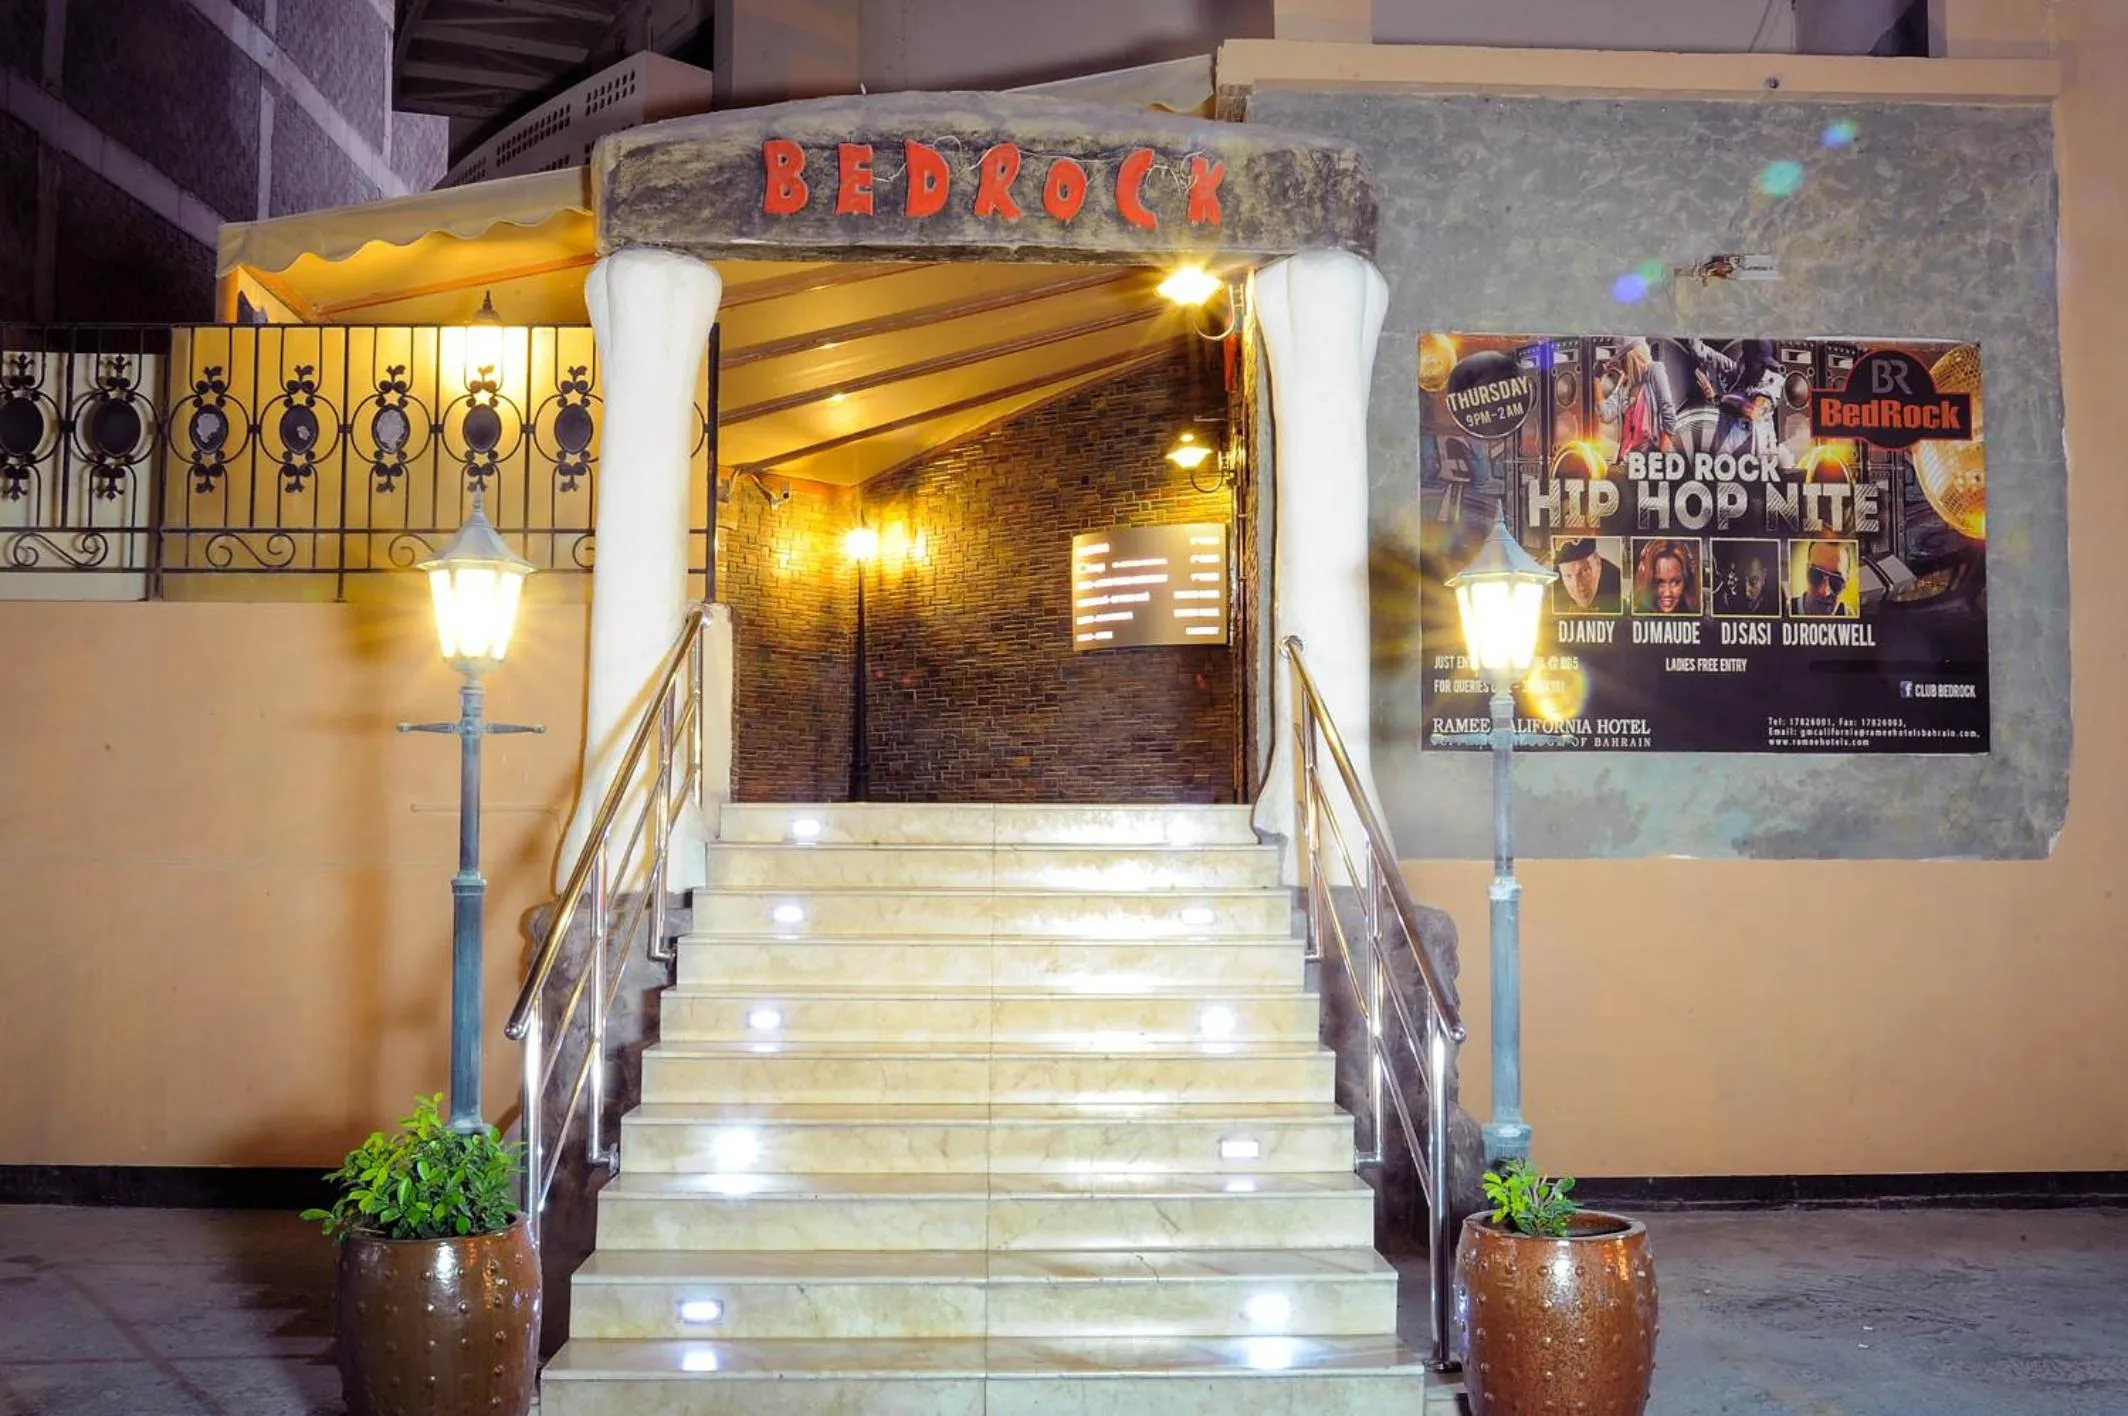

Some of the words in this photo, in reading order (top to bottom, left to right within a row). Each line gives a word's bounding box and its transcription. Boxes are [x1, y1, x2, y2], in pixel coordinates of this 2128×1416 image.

[763, 138, 1224, 230] BEDROCK
[1871, 359, 1913, 394] BR
[1447, 375, 1529, 412] THURSDAY
[1820, 398, 1961, 429] BedRock
[1628, 453, 1685, 481] BED
[1695, 453, 1781, 482] ROCK
[1527, 479, 1620, 528] HIP
[1637, 481, 1748, 530] HOP
[1766, 482, 1880, 533] NITE
[1434, 656, 1454, 669] JUST
[1665, 657, 1695, 672] LADIES
[1697, 658, 1718, 672] FREE
[1720, 658, 1747, 672] ENTRY
[1434, 679, 1450, 693] FOR
[1453, 680, 1489, 693] QUERIES
[1914, 684, 1937, 698] CLUB
[1938, 684, 1976, 698] BEDROCK
[1432, 718, 1491, 733] RAMEE
[1511, 718, 1592, 734] LIFORNIA
[1596, 719, 1651, 734] HOTEL
[1594, 738, 1651, 747] BAHRAIN
